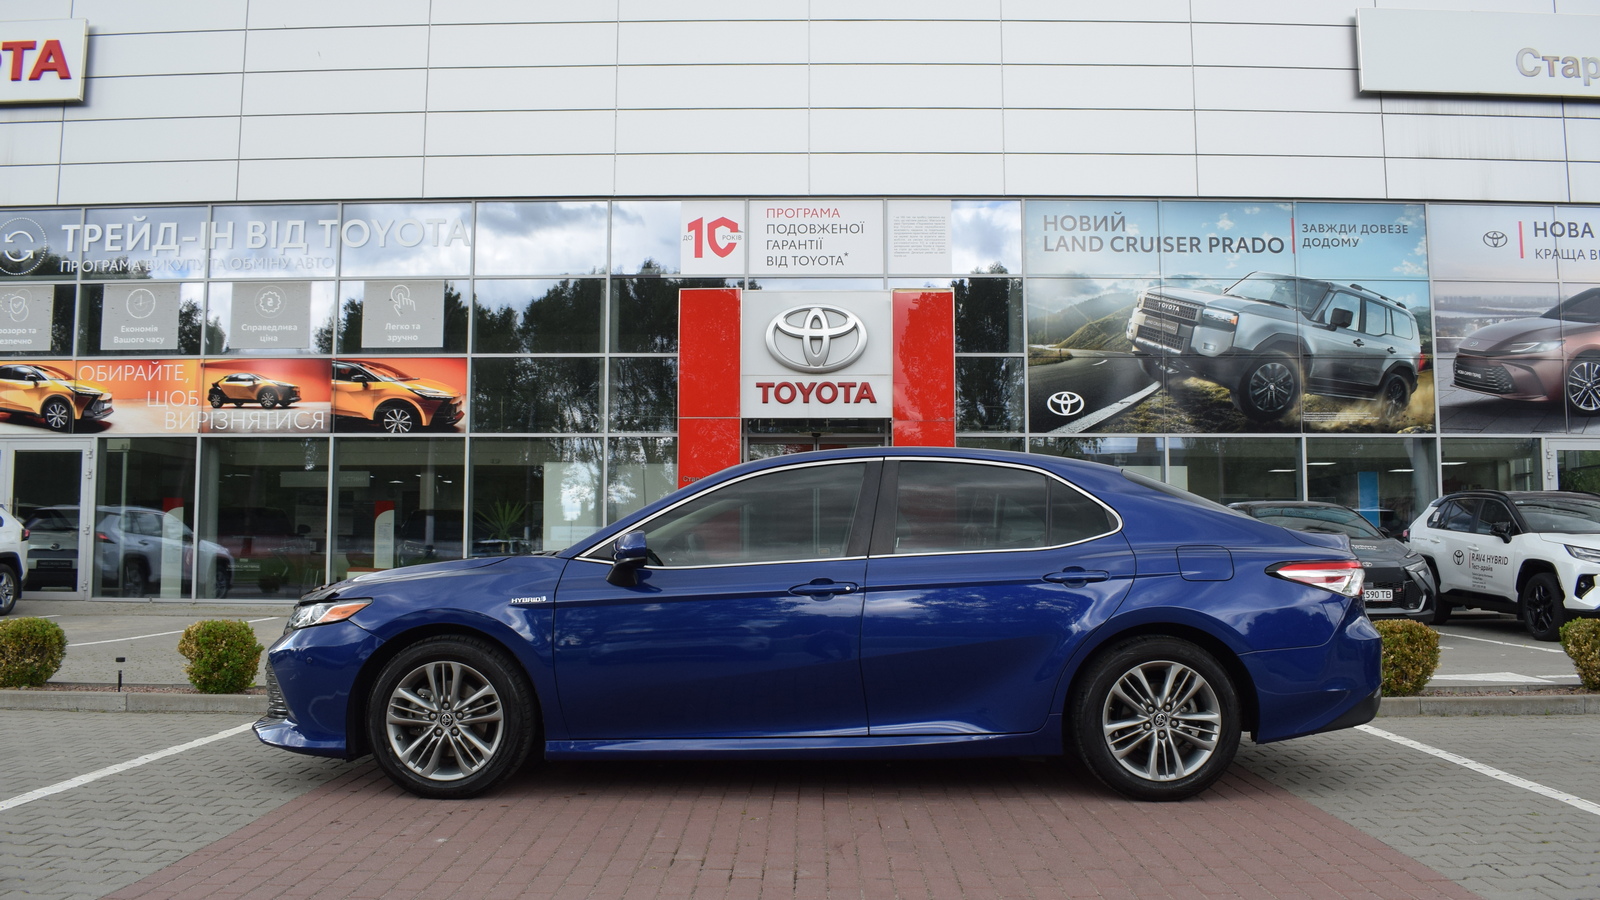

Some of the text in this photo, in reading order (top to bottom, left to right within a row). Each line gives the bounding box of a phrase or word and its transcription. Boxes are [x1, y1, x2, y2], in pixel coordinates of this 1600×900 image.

[0, 40, 72, 81] TA
[766, 208, 841, 219] ПРОГРАМА
[766, 221, 865, 236] ПОДОВЖЕНОЇ
[1043, 211, 1126, 232] НОВИЙ
[61, 216, 472, 257] ТРЕЙД-ІН ВІД TOYOTA
[1301, 223, 1409, 236] ЗАВЖДИ ДОВЕЗЕ
[1533, 221, 1595, 238] НОВА
[766, 237, 824, 250] ГАРАНТІЇ
[1043, 235, 1285, 254] LAND CRUISER PRADO
[1302, 237, 1360, 249] ДОДОМУ
[766, 256, 788, 268] ВІД
[1535, 248, 1600, 262] КРАЩА В
[60, 259, 141, 272] ПРОГРАМА
[209, 257, 227, 270] ТА
[231, 257, 292, 270] ОБМІНУ
[296, 256, 335, 269] АВТО
[1157, 301, 1180, 312] TOYOTA
[120, 325, 159, 333] Економія
[241, 323, 298, 333] Справедлива
[385, 323, 421, 331] Легко та
[113, 336, 165, 345] Вашого часу
[259, 334, 279, 343] ціна
[387, 334, 418, 342] зручно
[78, 361, 190, 383] ОБИРАЙТЕ,
[147, 390, 199, 410] ЩОБ
[756, 382, 877, 404] TOYOTA
[165, 411, 325, 430] ВИРІЗНЯТИСЯ
[1471, 552, 1509, 566] RAV4 HYBRID
